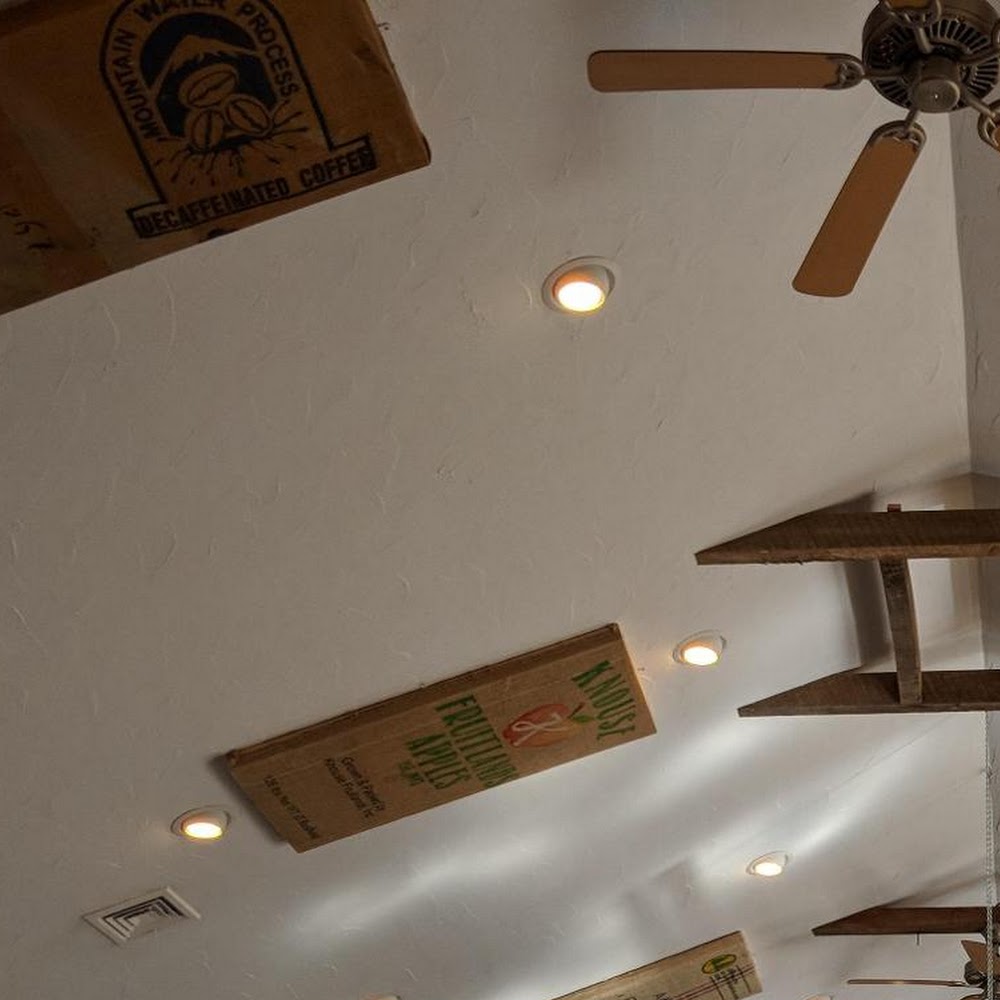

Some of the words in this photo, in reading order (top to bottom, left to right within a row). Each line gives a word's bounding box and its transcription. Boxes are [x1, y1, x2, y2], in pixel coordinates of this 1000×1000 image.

[110, 28, 156, 140] MOUNTAIN
[236, 4, 299, 98] PROCESS
[136, 178, 290, 236] DECAFFEINATED
